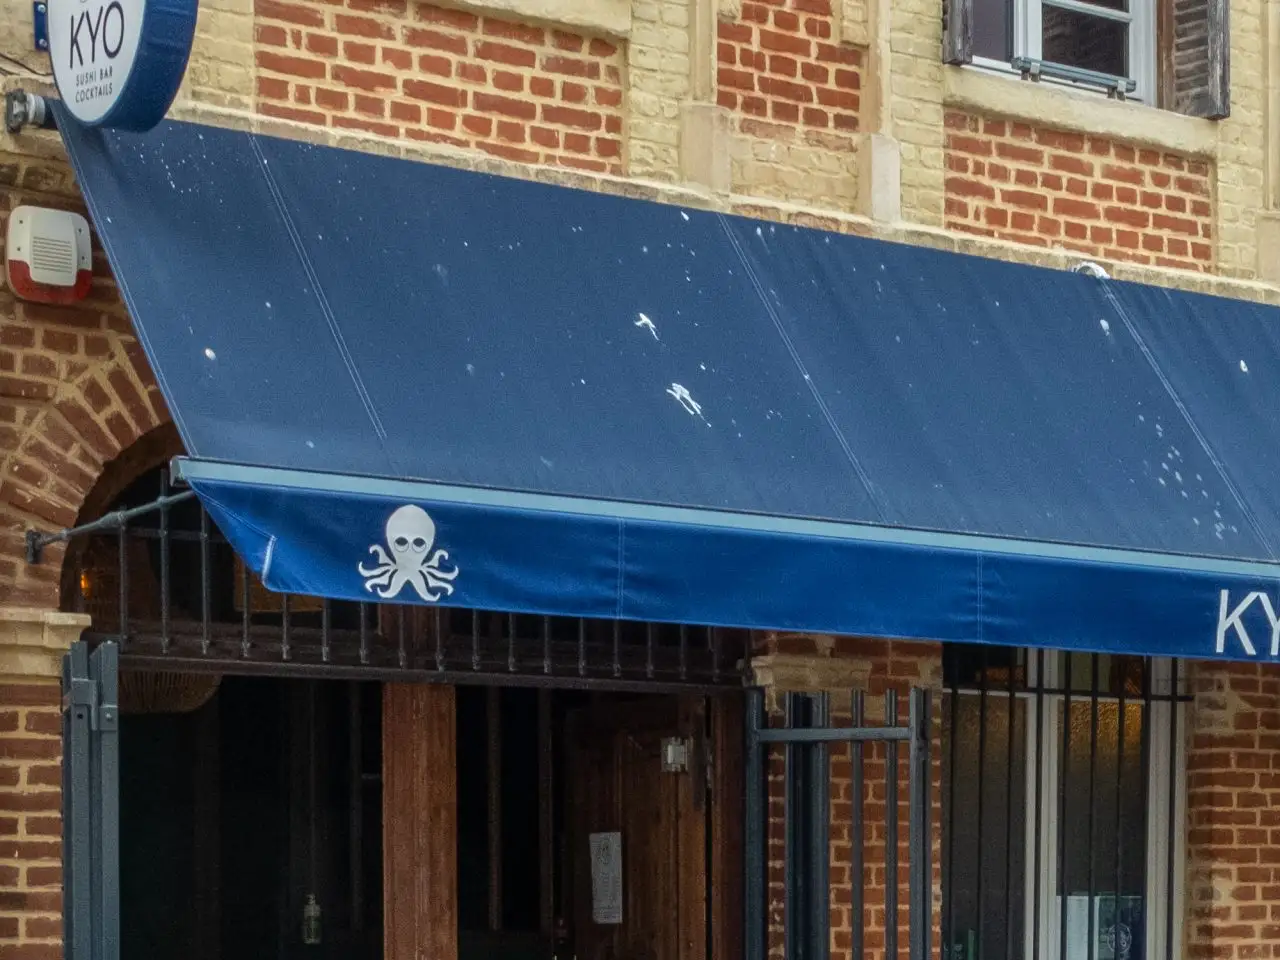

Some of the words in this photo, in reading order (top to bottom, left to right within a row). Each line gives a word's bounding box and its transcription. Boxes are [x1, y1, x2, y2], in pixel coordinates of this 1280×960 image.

[69, 1, 125, 70] KYO
[75, 70, 97, 87] SUSHI
[99, 66, 113, 80] BAR
[75, 82, 113, 103] COCKTAILS
